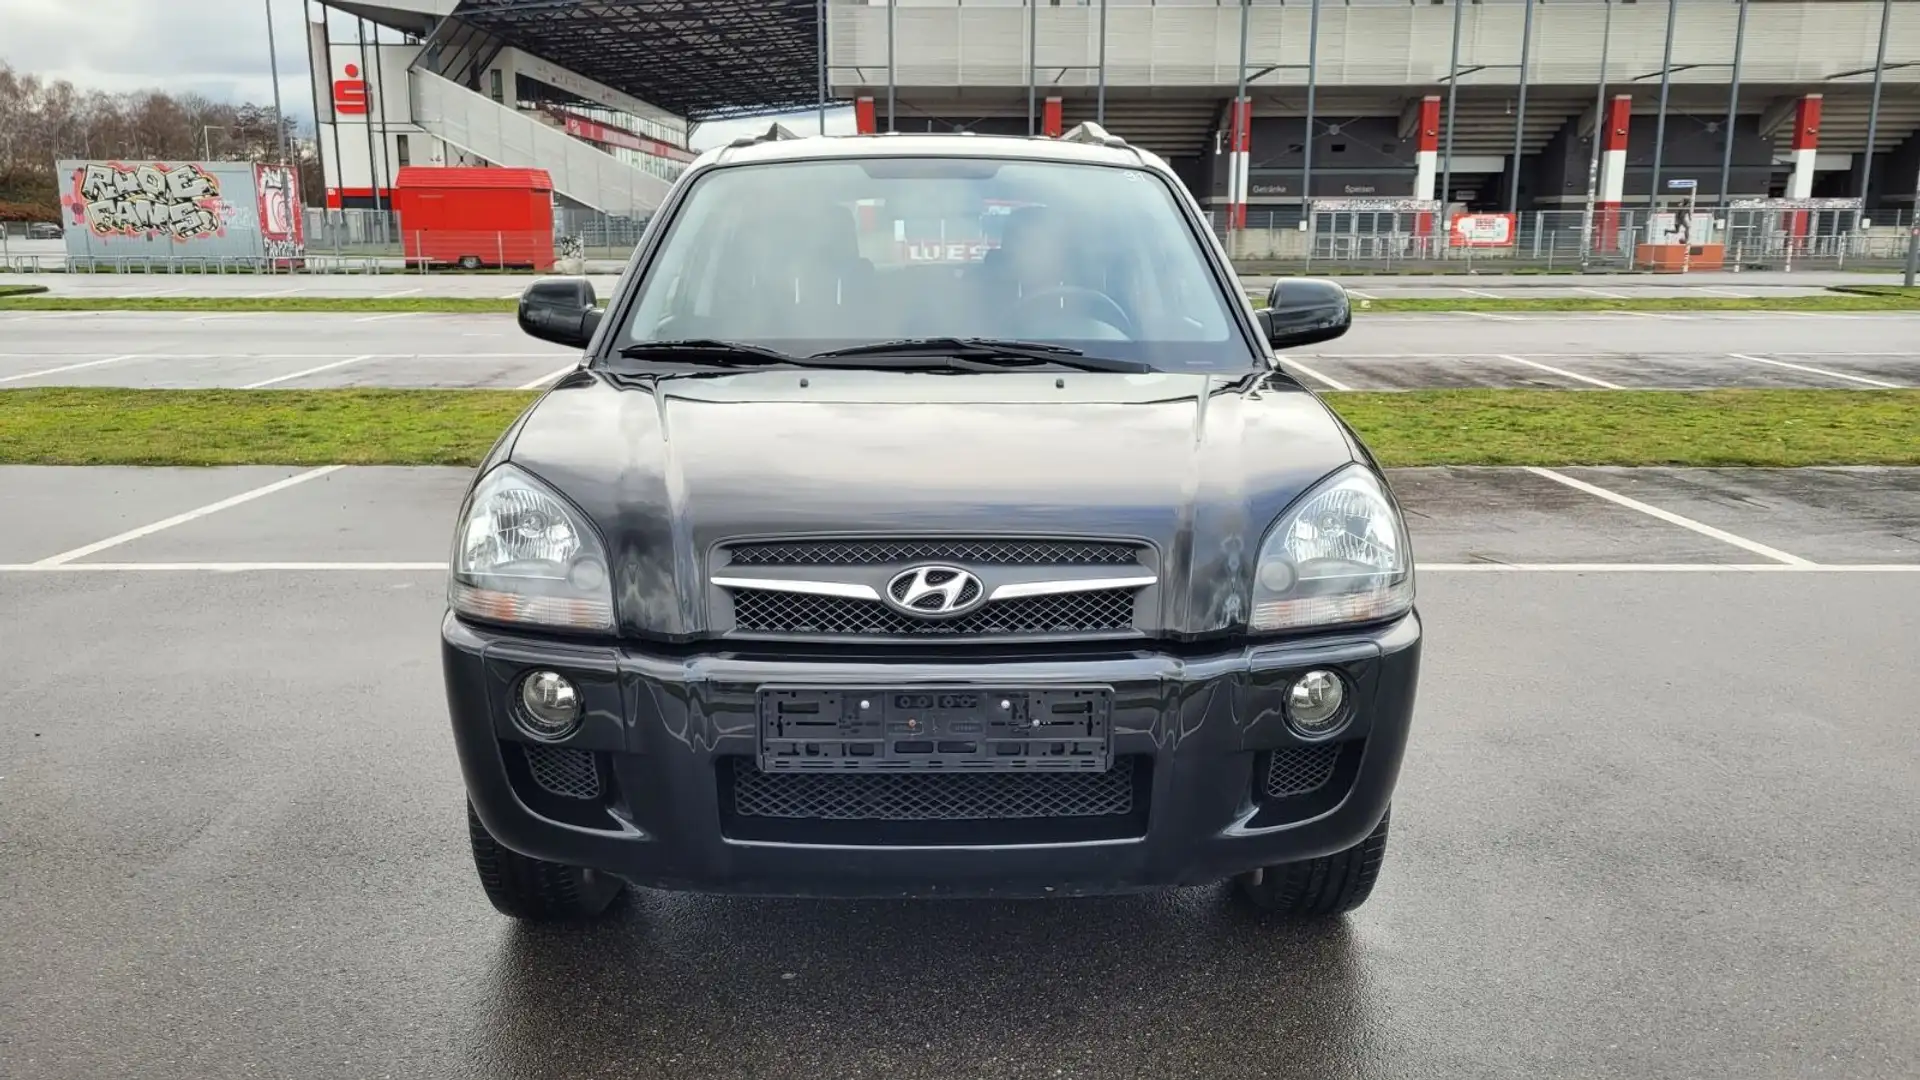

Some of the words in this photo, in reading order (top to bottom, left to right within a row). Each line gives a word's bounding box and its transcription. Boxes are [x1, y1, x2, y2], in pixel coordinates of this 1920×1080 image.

[1252, 184, 1287, 194] Getränke
[1344, 184, 1375, 195] Speisen
[909, 245, 999, 260] WES
